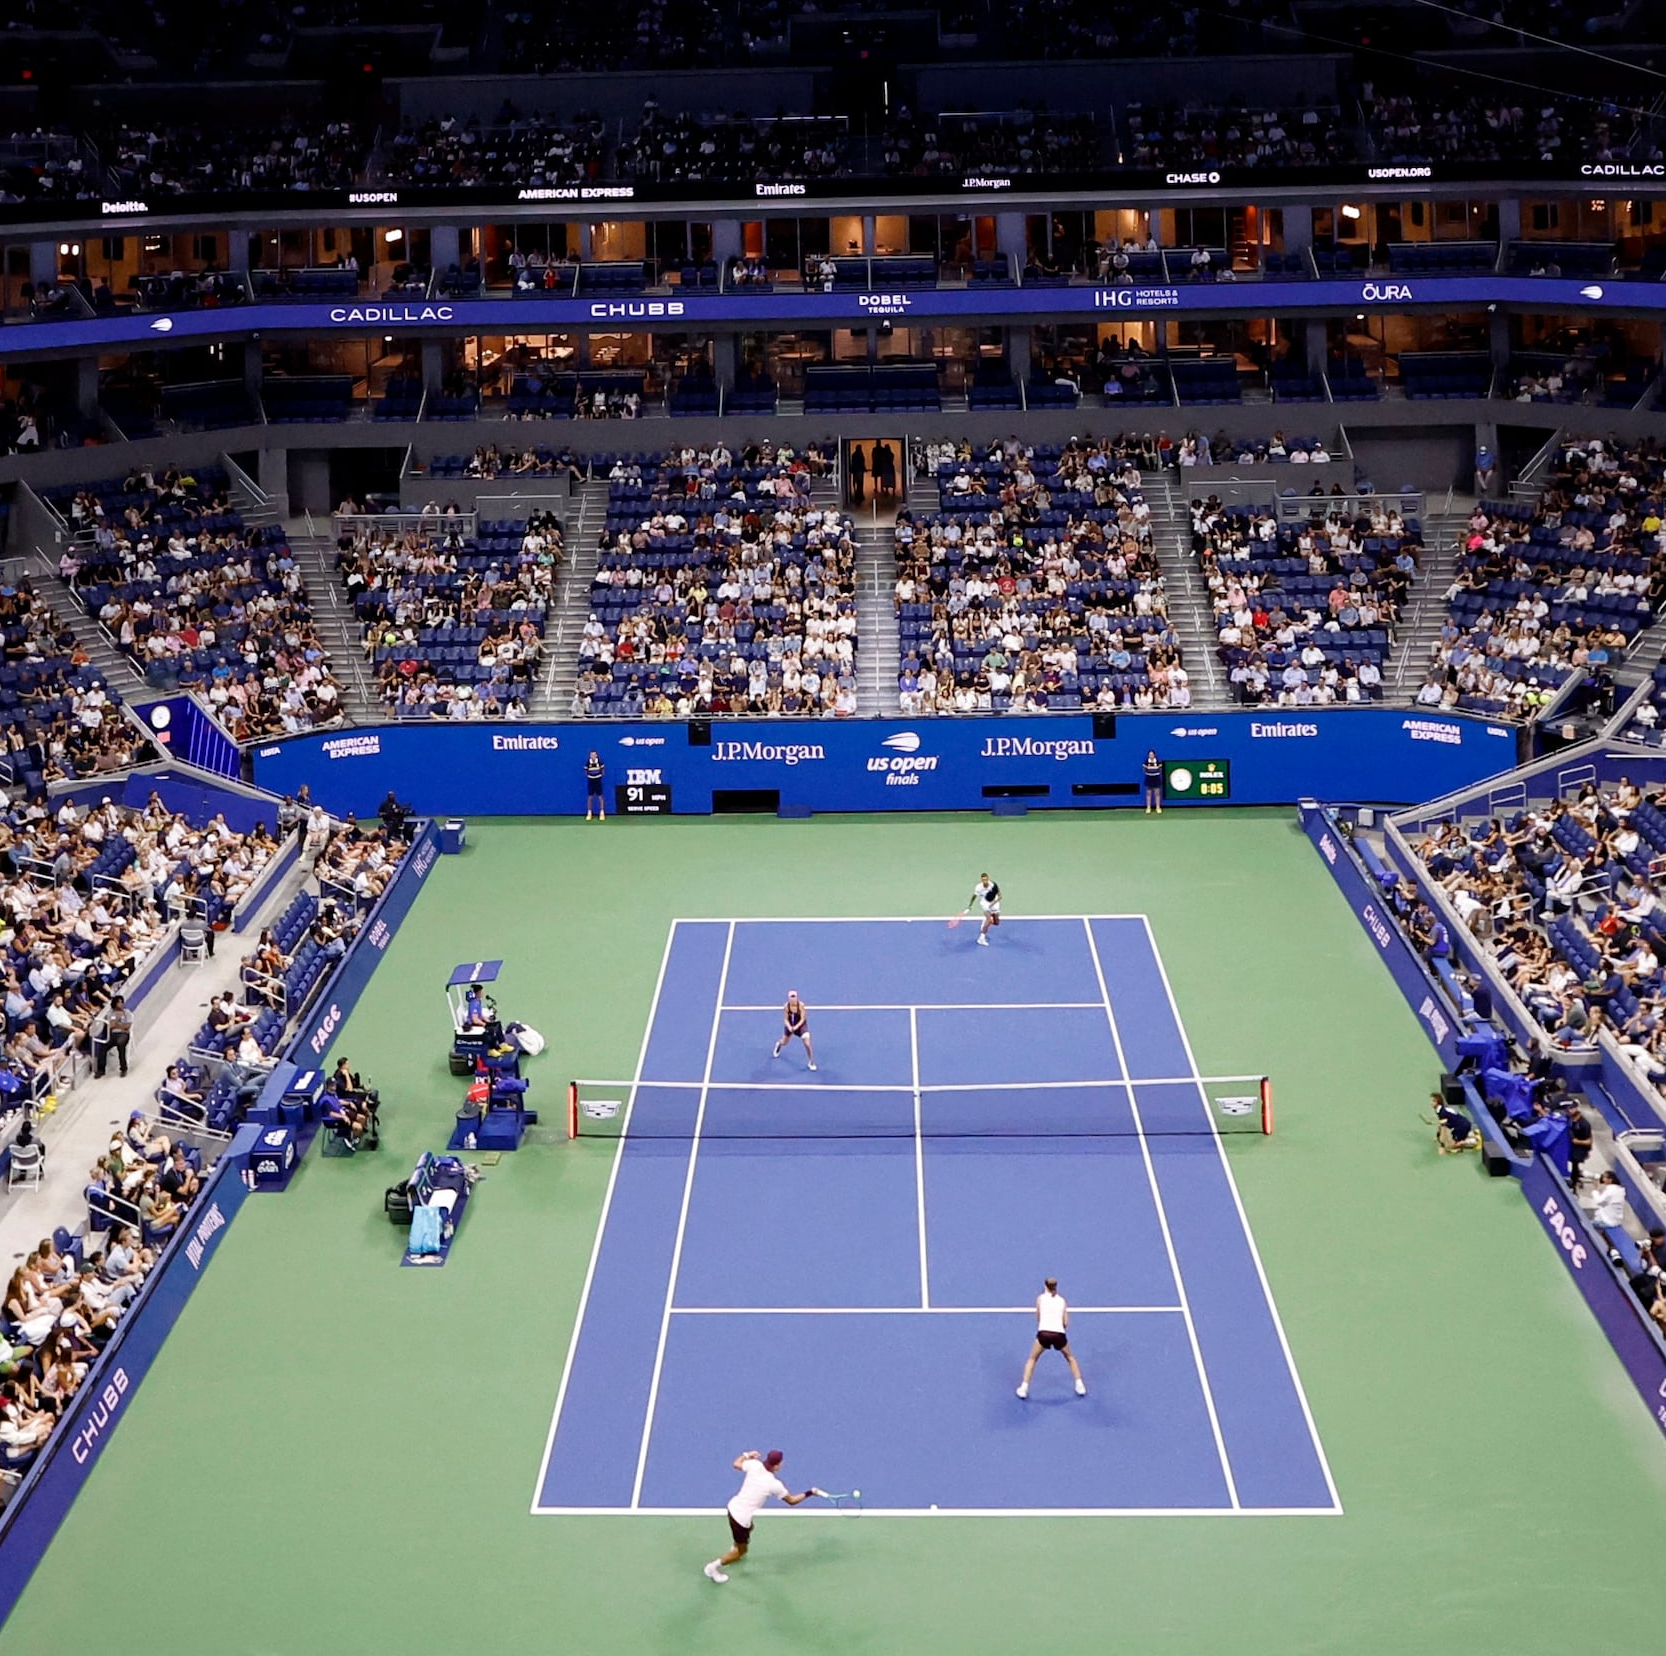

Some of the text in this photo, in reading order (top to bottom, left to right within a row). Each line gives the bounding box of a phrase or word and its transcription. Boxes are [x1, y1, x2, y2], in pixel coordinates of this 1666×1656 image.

[1369, 167, 1431, 178] USOPEN.ORG
[1581, 165, 1664, 175] CADILLAC
[962, 178, 1010, 188] J.P.Morgan
[1167, 173, 1205, 183] CHASE
[518, 188, 634, 199] AMERICAN EXPRESS
[756, 183, 805, 195] Emirates
[349, 193, 397, 202] #USOPEN
[102, 201, 148, 213] Deloitte.
[859, 295, 911, 305] DOBEL
[1096, 291, 1131, 306] IHG
[331, 307, 452, 321] CADILLAC
[591, 303, 683, 316] CHUBB
[1197, 728, 1218, 737] open
[1251, 722, 1317, 737] Emirates
[1403, 720, 1460, 736] AMERICAN
[493, 735, 558, 749] Emirates
[645, 737, 665, 746] open
[1411, 729, 1461, 744] EXPRESS
[322, 736, 380, 752] AMERICAN
[328, 743, 380, 758] EXPRESS
[981, 738, 1094, 760] J.P.Morgan
[712, 742, 824, 765] J.P.Morgan
[867, 756, 938, 775] us open
[626, 769, 662, 785] IBM
[886, 773, 919, 785] finals
[627, 787, 644, 801] 91
[1200, 783, 1224, 795] 0:05
[1363, 905, 1391, 948] CHUBB
[72, 1367, 130, 1464] CHUBB
